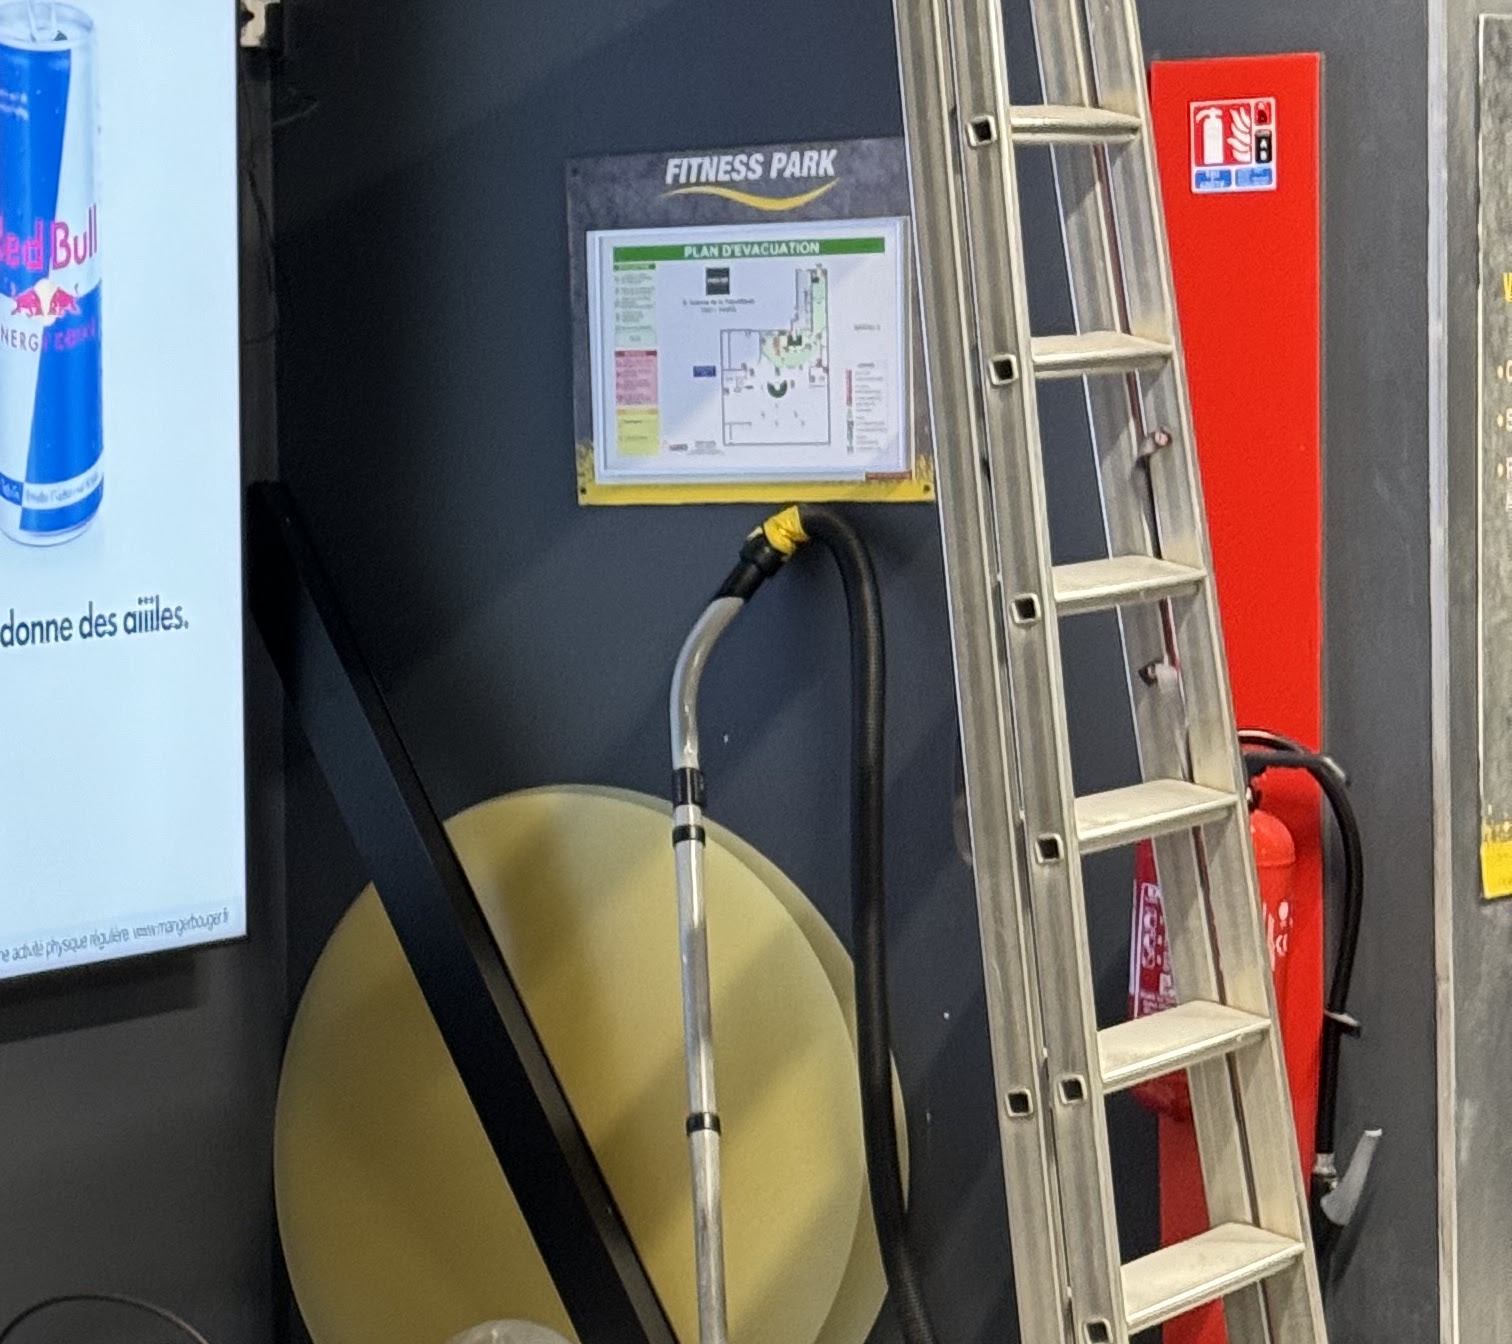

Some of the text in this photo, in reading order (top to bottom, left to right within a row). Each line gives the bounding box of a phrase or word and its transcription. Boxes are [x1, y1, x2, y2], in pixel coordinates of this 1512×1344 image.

[665, 149, 837, 185] FITNESS PARK
[50, 203, 97, 271] Bull
[684, 241, 820, 258] PLAN D'EVACUATION
[0, 608, 73, 648] donne
[78, 601, 117, 639] des
[46, 933, 87, 961] physique
